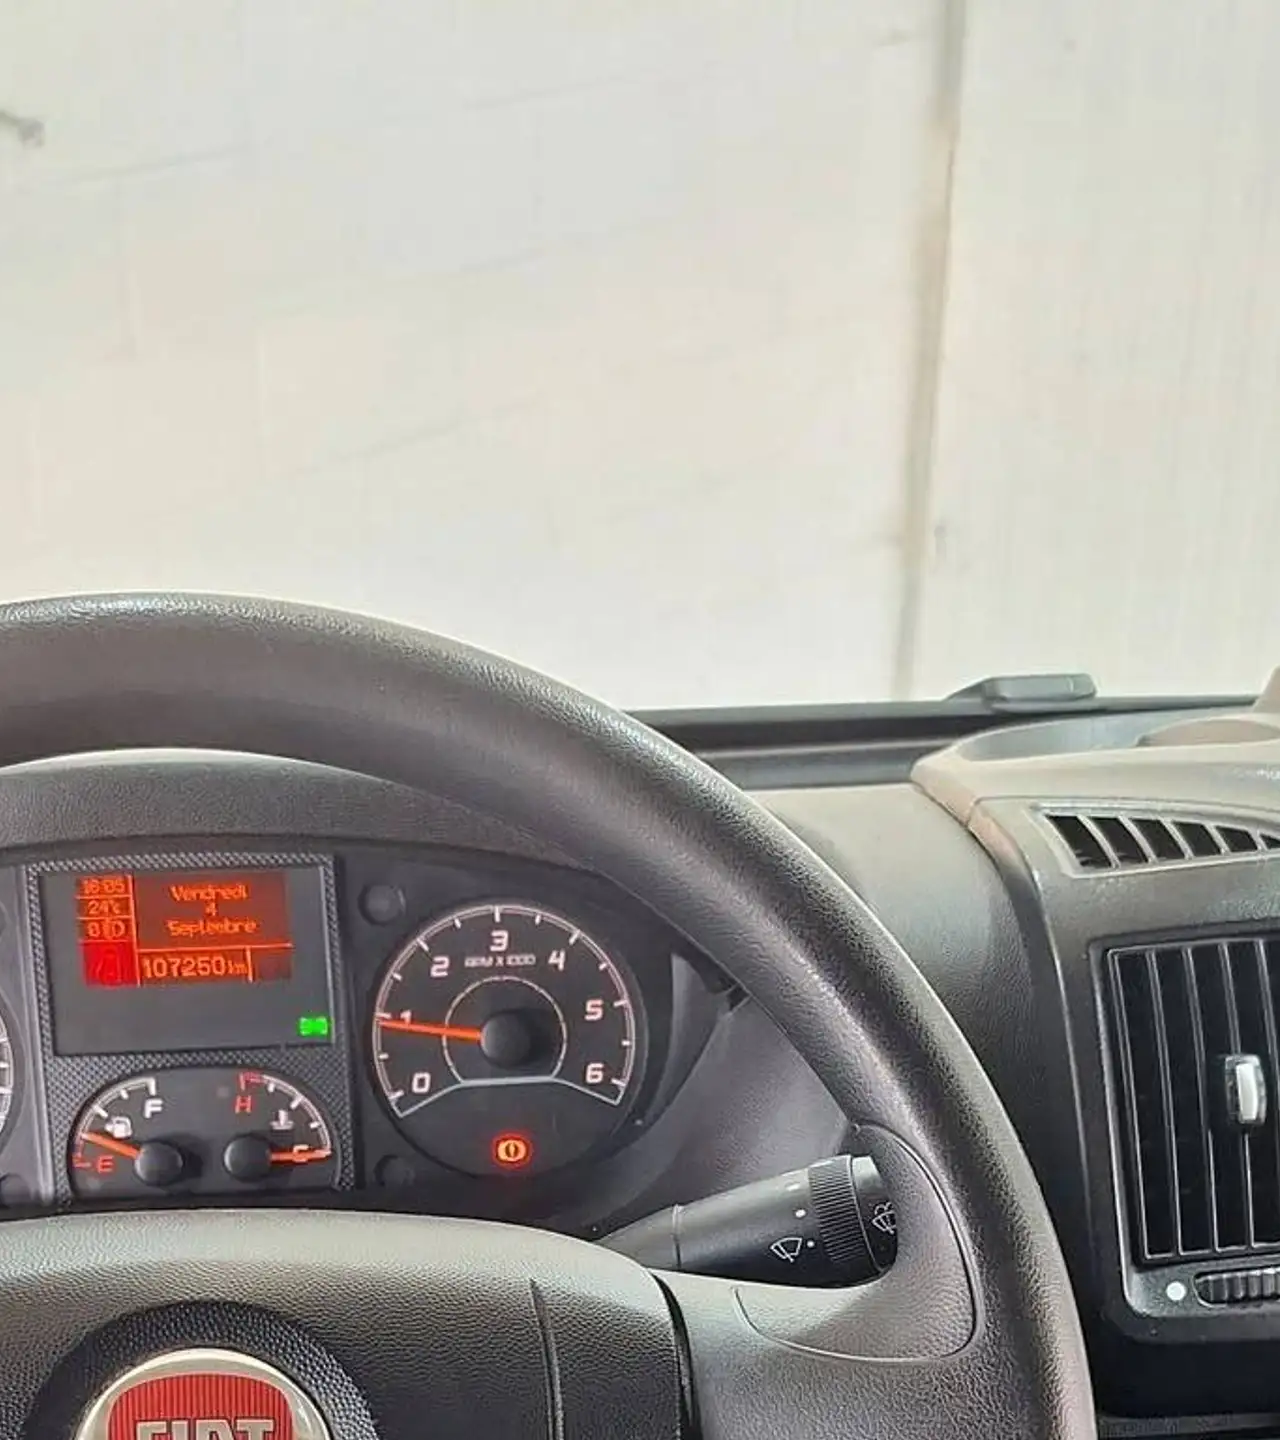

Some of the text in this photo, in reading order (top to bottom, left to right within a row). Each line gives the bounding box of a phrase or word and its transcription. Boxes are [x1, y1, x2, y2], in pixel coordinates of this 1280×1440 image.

[168, 917, 258, 937] Septembre
[490, 930, 509, 952] 3
[430, 956, 449, 978] 2
[548, 951, 566, 972] 4
[585, 999, 604, 1021] 5
[412, 1072, 431, 1093] 0
[586, 1063, 604, 1084] 6
[144, 1099, 163, 1118] F
[235, 1095, 252, 1113] H
[97, 1155, 114, 1172] E
